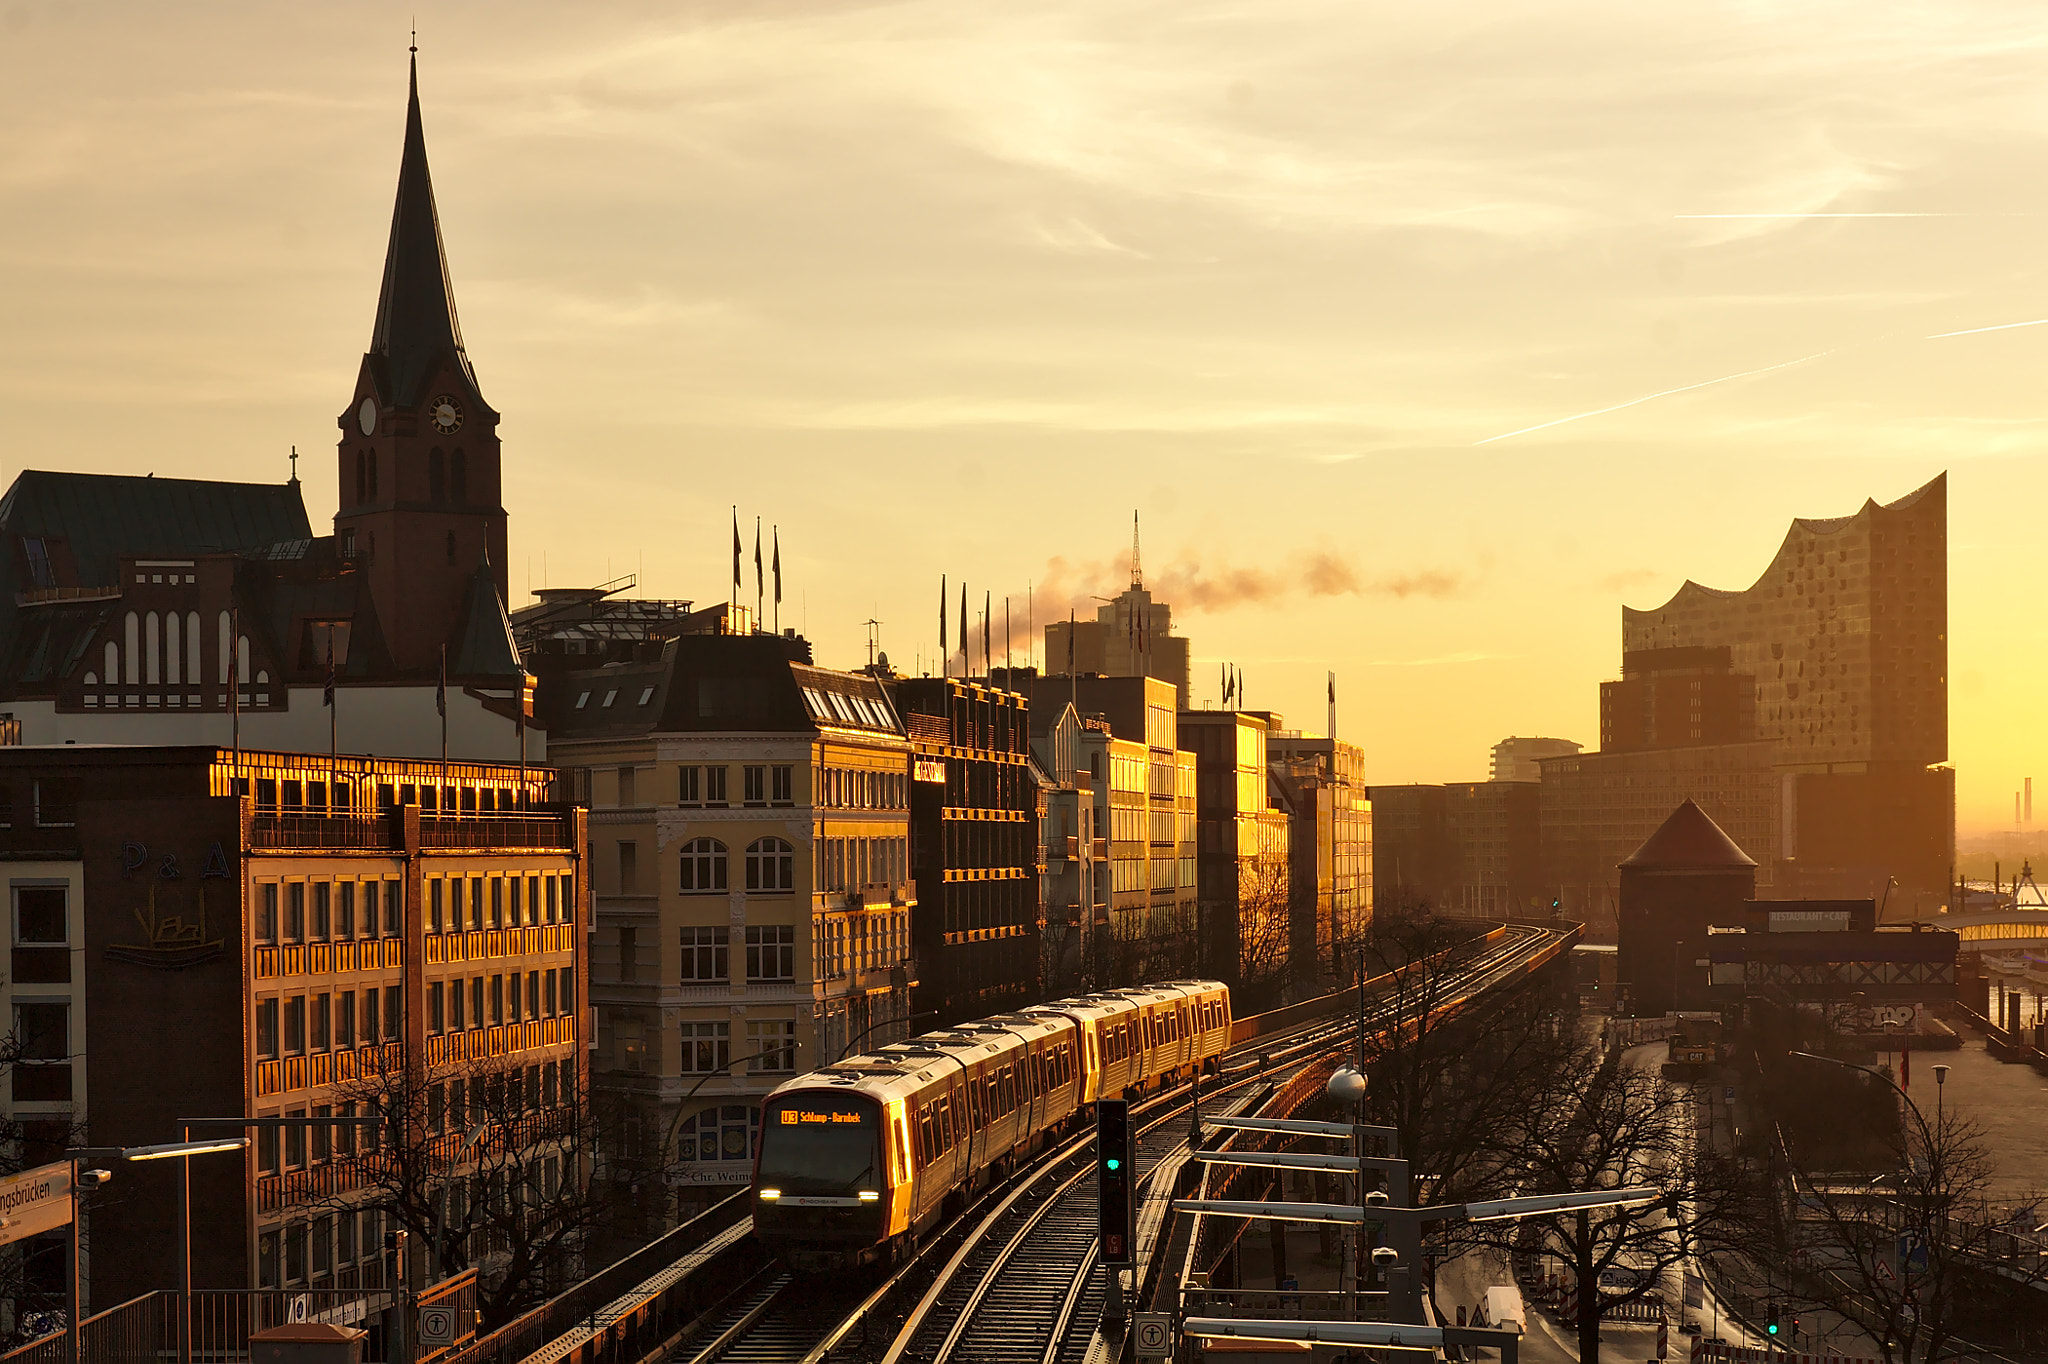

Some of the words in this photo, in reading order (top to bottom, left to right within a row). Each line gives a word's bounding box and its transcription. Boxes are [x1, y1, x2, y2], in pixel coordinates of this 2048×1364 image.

[123, 841, 147, 878] P
[160, 853, 180, 878] &
[200, 840, 231, 879] A
[1771, 911, 1823, 921] RESTAURANT
[1689, 1052, 1704, 1061] CAT
[1726, 1087, 1733, 1097] P
[782, 1110, 798, 1124] U3
[800, 1111, 828, 1123] Schlump
[832, 1111, 861, 1123] Barmbek
[691, 1172, 714, 1181] Chr.
